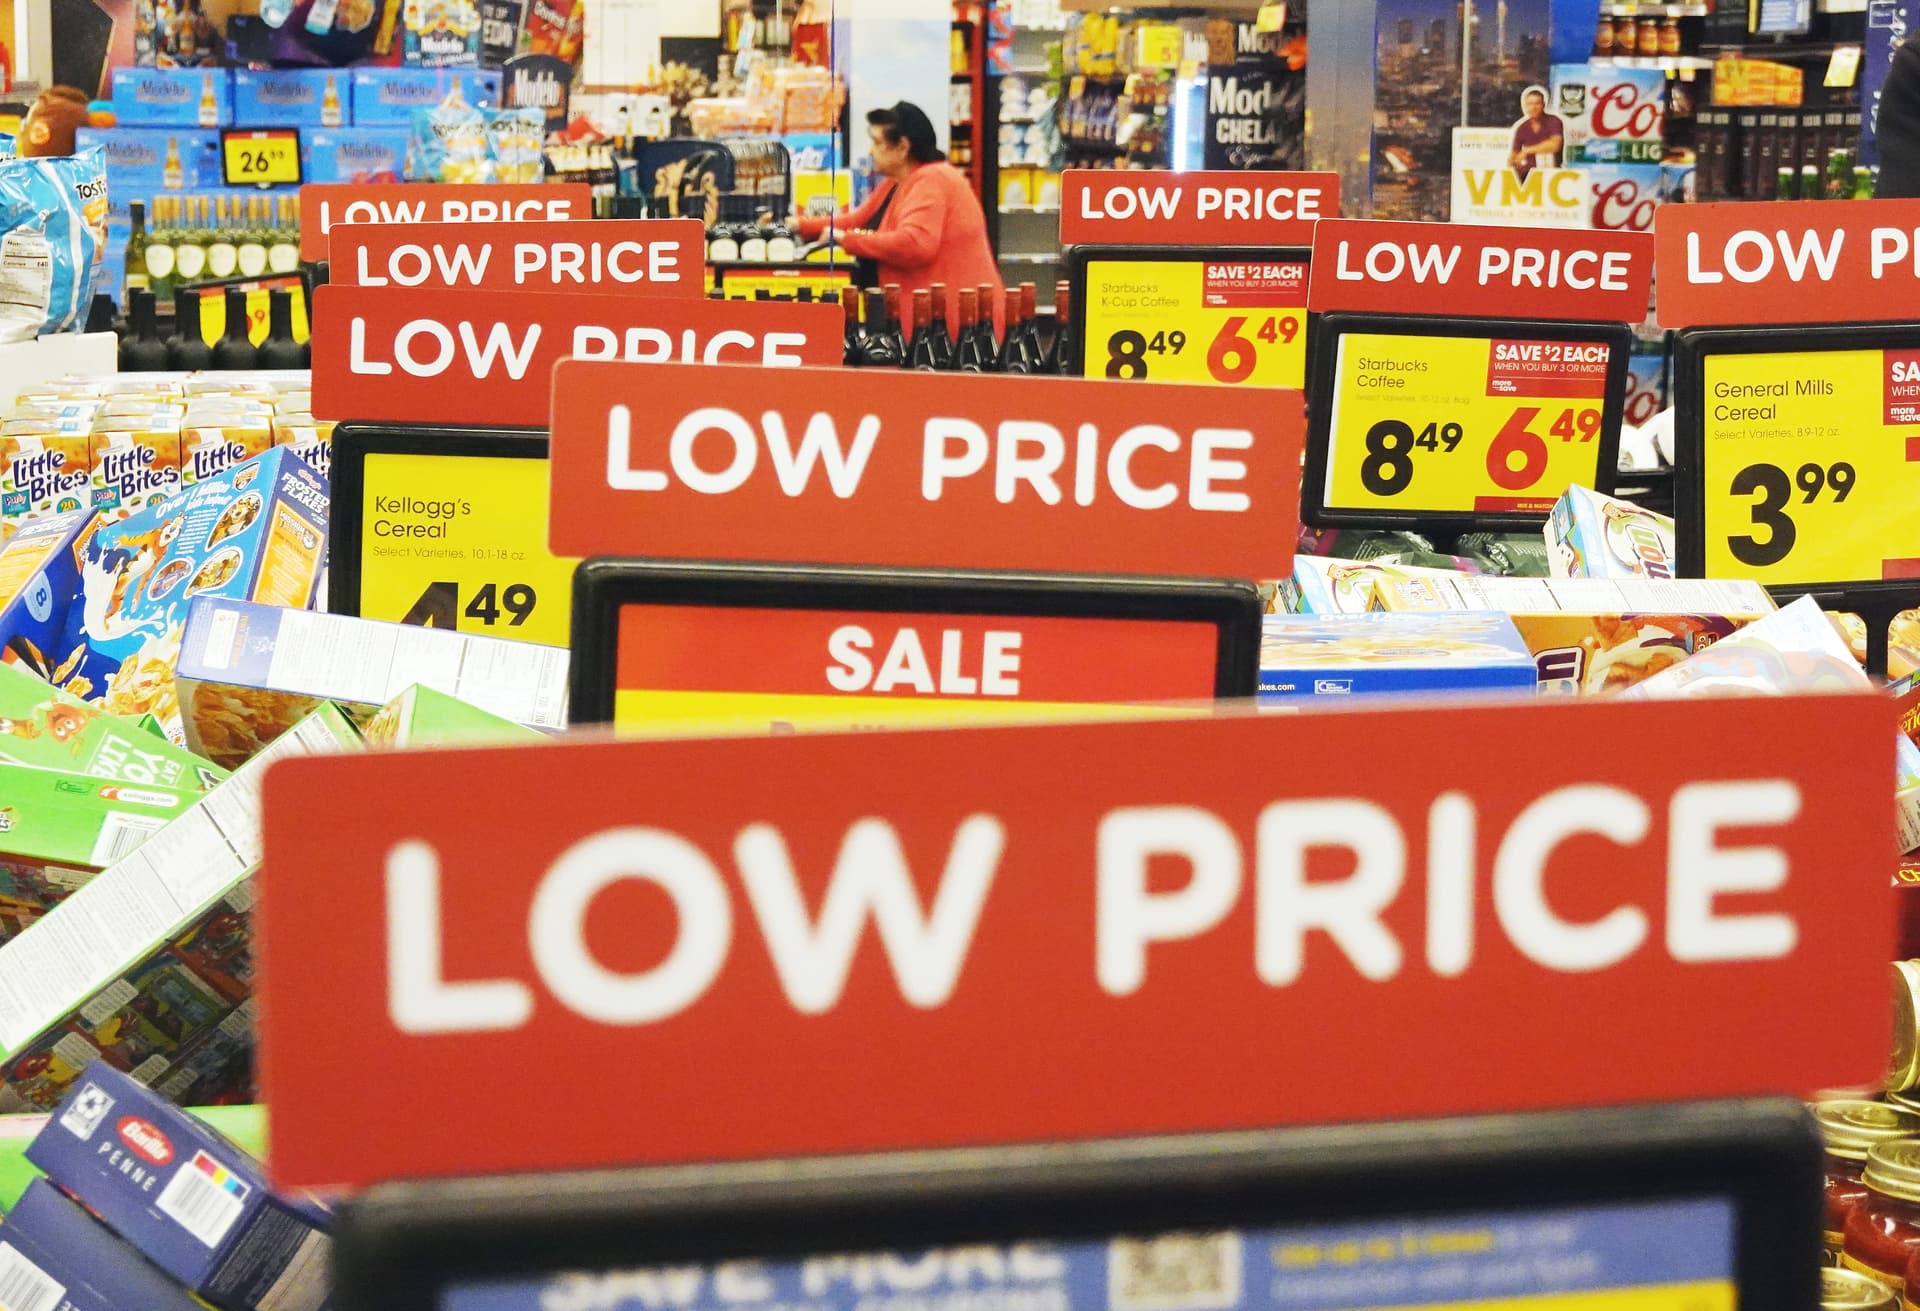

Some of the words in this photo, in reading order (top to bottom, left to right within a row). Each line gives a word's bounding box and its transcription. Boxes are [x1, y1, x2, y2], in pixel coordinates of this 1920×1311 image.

[1591, 82, 1664, 138] Co
[1081, 186, 1182, 220] LOW
[1196, 188, 1321, 220] PRICE
[1463, 169, 1581, 208] VMC
[320, 201, 426, 235] LOW
[443, 200, 572, 221] PRICE
[357, 243, 492, 287] LOW
[514, 241, 681, 284] PRICE
[1336, 240, 1462, 284] LOW
[1478, 246, 1632, 291] PRICE
[1687, 228, 1846, 284] LOW
[1870, 226, 1920, 280] P
[1101, 282, 1159, 294] Starbucks
[1207, 265, 1246, 279] SAVE
[1247, 265, 1261, 279] $2
[1263, 265, 1303, 279] EACH
[1139, 296, 1180, 308] Coffee
[350, 316, 542, 380] LOW
[572, 325, 807, 369] PRICE
[1358, 357, 1429, 372] Starbucks
[1495, 344, 1542, 361] SAVE
[1544, 344, 1561, 361] $2
[1563, 346, 1610, 363] EACH
[1357, 374, 1405, 388] Coffee
[1494, 362, 1520, 371] WHEN
[1521, 363, 1540, 372] YOU
[1541, 363, 1558, 372] BUY
[1559, 364, 1565, 372] 3
[1566, 364, 1579, 373] OR
[1580, 364, 1606, 373] MORE
[1714, 380, 1789, 398] General
[1795, 379, 1834, 396] Mills
[1714, 403, 1776, 421] Cereal
[1890, 407, 1916, 415] more
[1713, 429, 1746, 440] Select
[13, 450, 65, 488] Little
[104, 446, 155, 484] Little
[194, 442, 245, 480] Little
[606, 404, 881, 499] LOW
[921, 417, 1254, 512] PRICE
[31, 470, 89, 503] Bites
[121, 466, 179, 498] Bites
[281, 472, 331, 507] FROSTED
[281, 483, 325, 514] FLAKES
[375, 495, 472, 520] Kellogg's
[374, 519, 447, 539] Cereal
[373, 546, 410, 558] Select
[825, 625, 1022, 696] SALE
[387, 816, 1004, 1034] LOW
[1096, 781, 1801, 994] PRICE
[97, 1141, 157, 1192] PENNE
